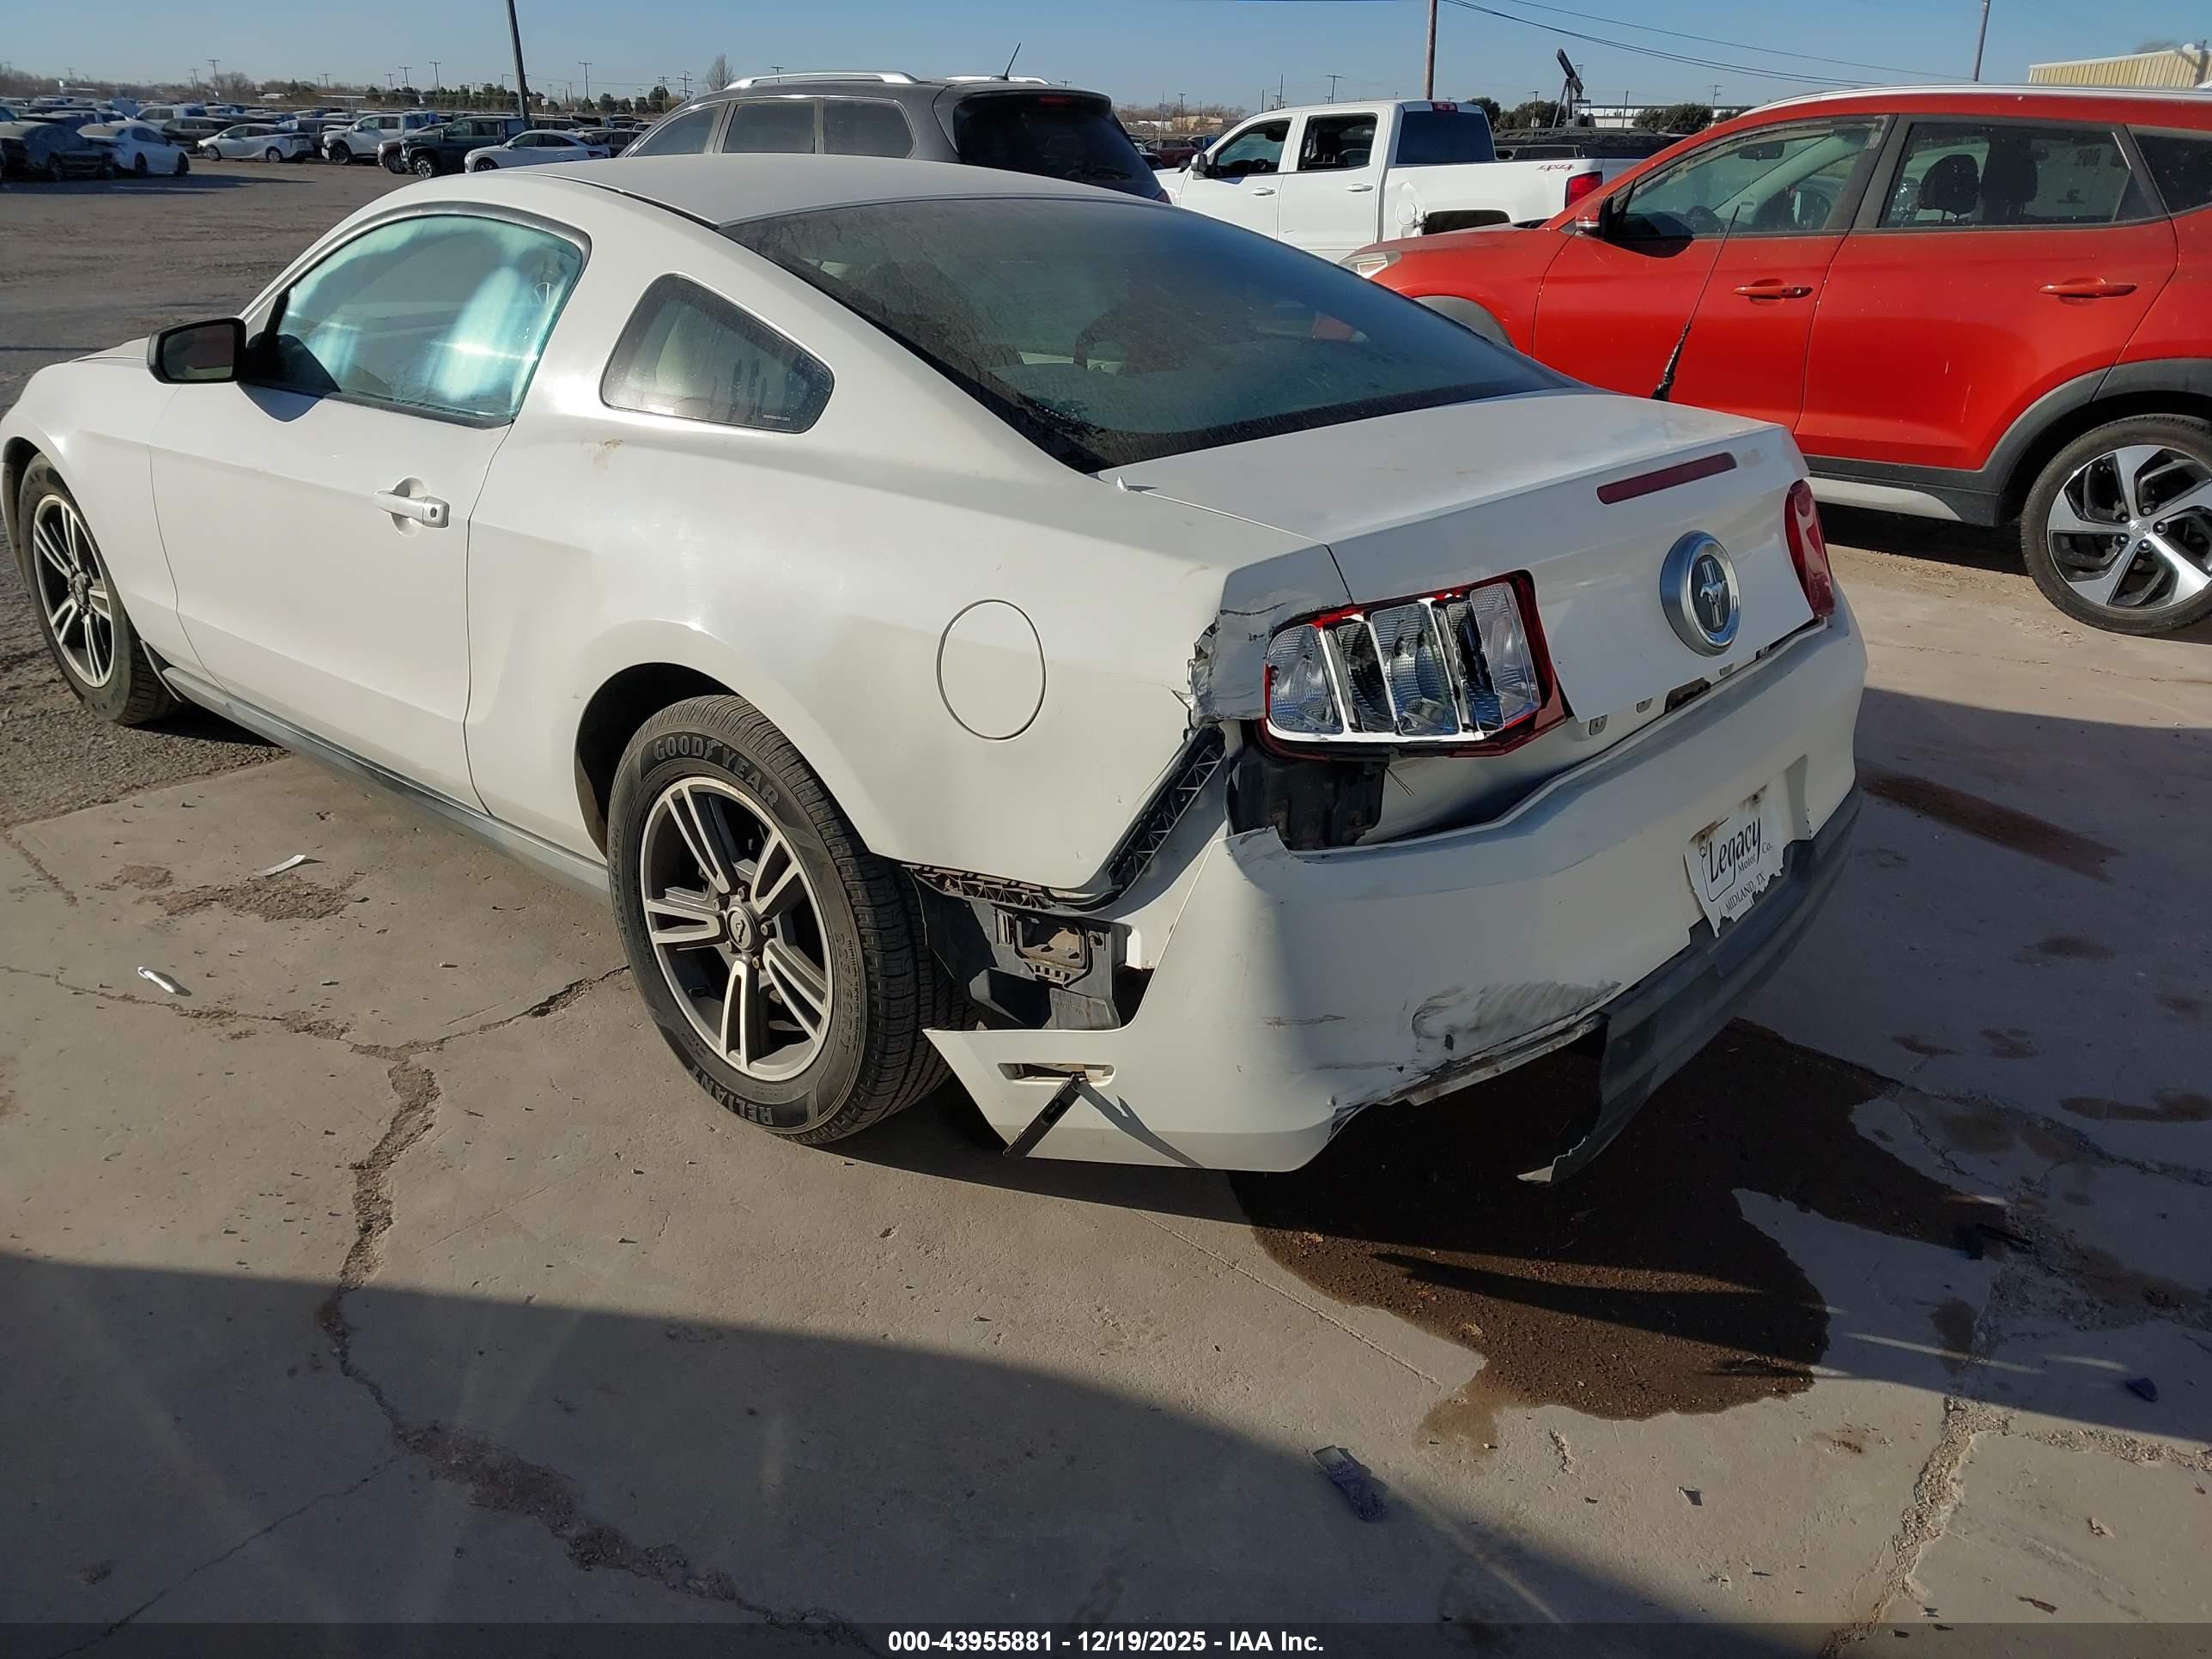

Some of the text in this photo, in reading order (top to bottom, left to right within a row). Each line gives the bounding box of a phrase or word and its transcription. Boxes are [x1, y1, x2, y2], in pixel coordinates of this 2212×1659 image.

[1708, 817, 1761, 885] Legacy
[1737, 842, 1773, 872] Motor Co.
[689, 1063, 775, 1126] RELIANT
